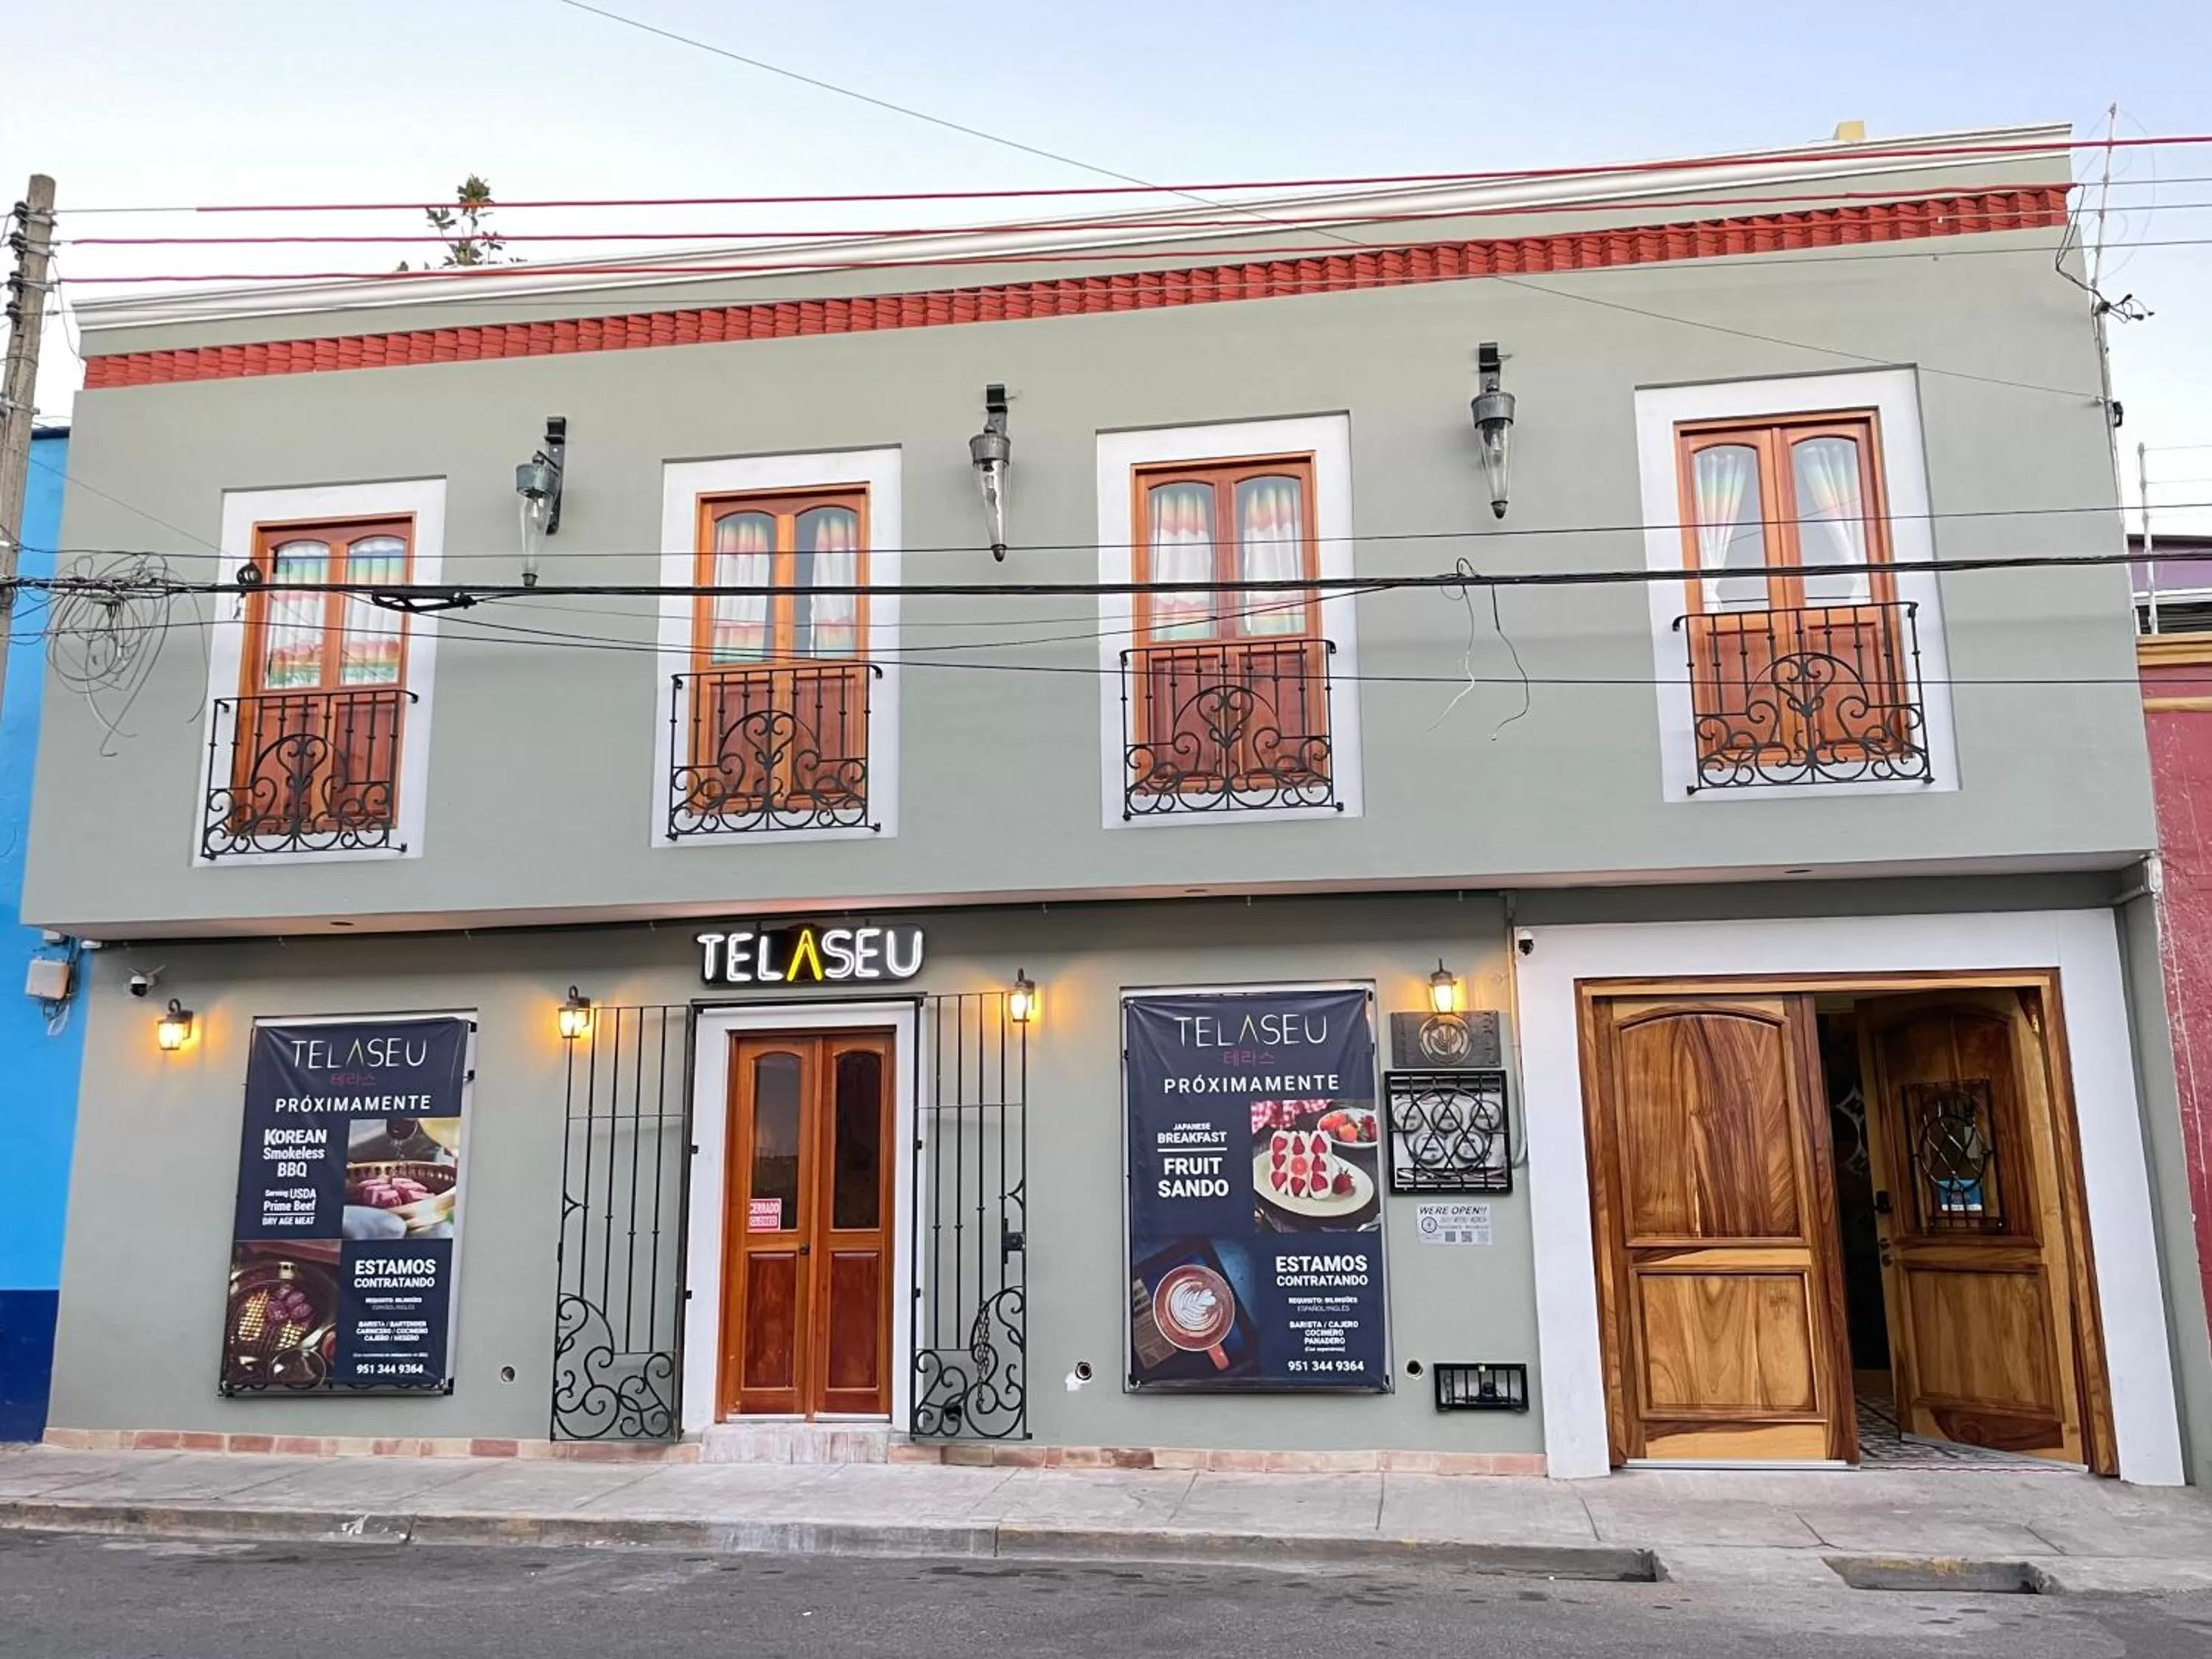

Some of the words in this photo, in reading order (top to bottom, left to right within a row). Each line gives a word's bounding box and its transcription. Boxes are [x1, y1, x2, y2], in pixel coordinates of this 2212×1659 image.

[1164, 1074, 1339, 1093] PRÓXIMAMENTE
[275, 1094, 431, 1113] PRÓXIMAMENTE
[1173, 1122, 1211, 1130] JAPANESE
[264, 1129, 327, 1145] KOREAN
[1157, 1131, 1228, 1144] BREAKFAST
[263, 1146, 325, 1160] Smokeless
[277, 1162, 307, 1178] BBQ
[1164, 1158, 1222, 1175] FRUIT
[290, 1188, 316, 1199] USDA
[1158, 1179, 1229, 1197] SANDO
[263, 1200, 292, 1211] Prime
[293, 1199, 316, 1211] Beef
[294, 1216, 316, 1225] MEAT
[355, 1259, 437, 1275] ESTAMOS
[1276, 1255, 1368, 1273] ESTAMOS
[354, 1277, 435, 1288] CONTRATANDO
[1276, 1275, 1368, 1287] CONTRATANDO
[356, 1363, 375, 1374] 951
[377, 1363, 396, 1374] 344
[398, 1363, 424, 1374] 9364
[1287, 1360, 1308, 1371] 951
[1312, 1360, 1333, 1371] 344
[1335, 1360, 1365, 1371] 9364
